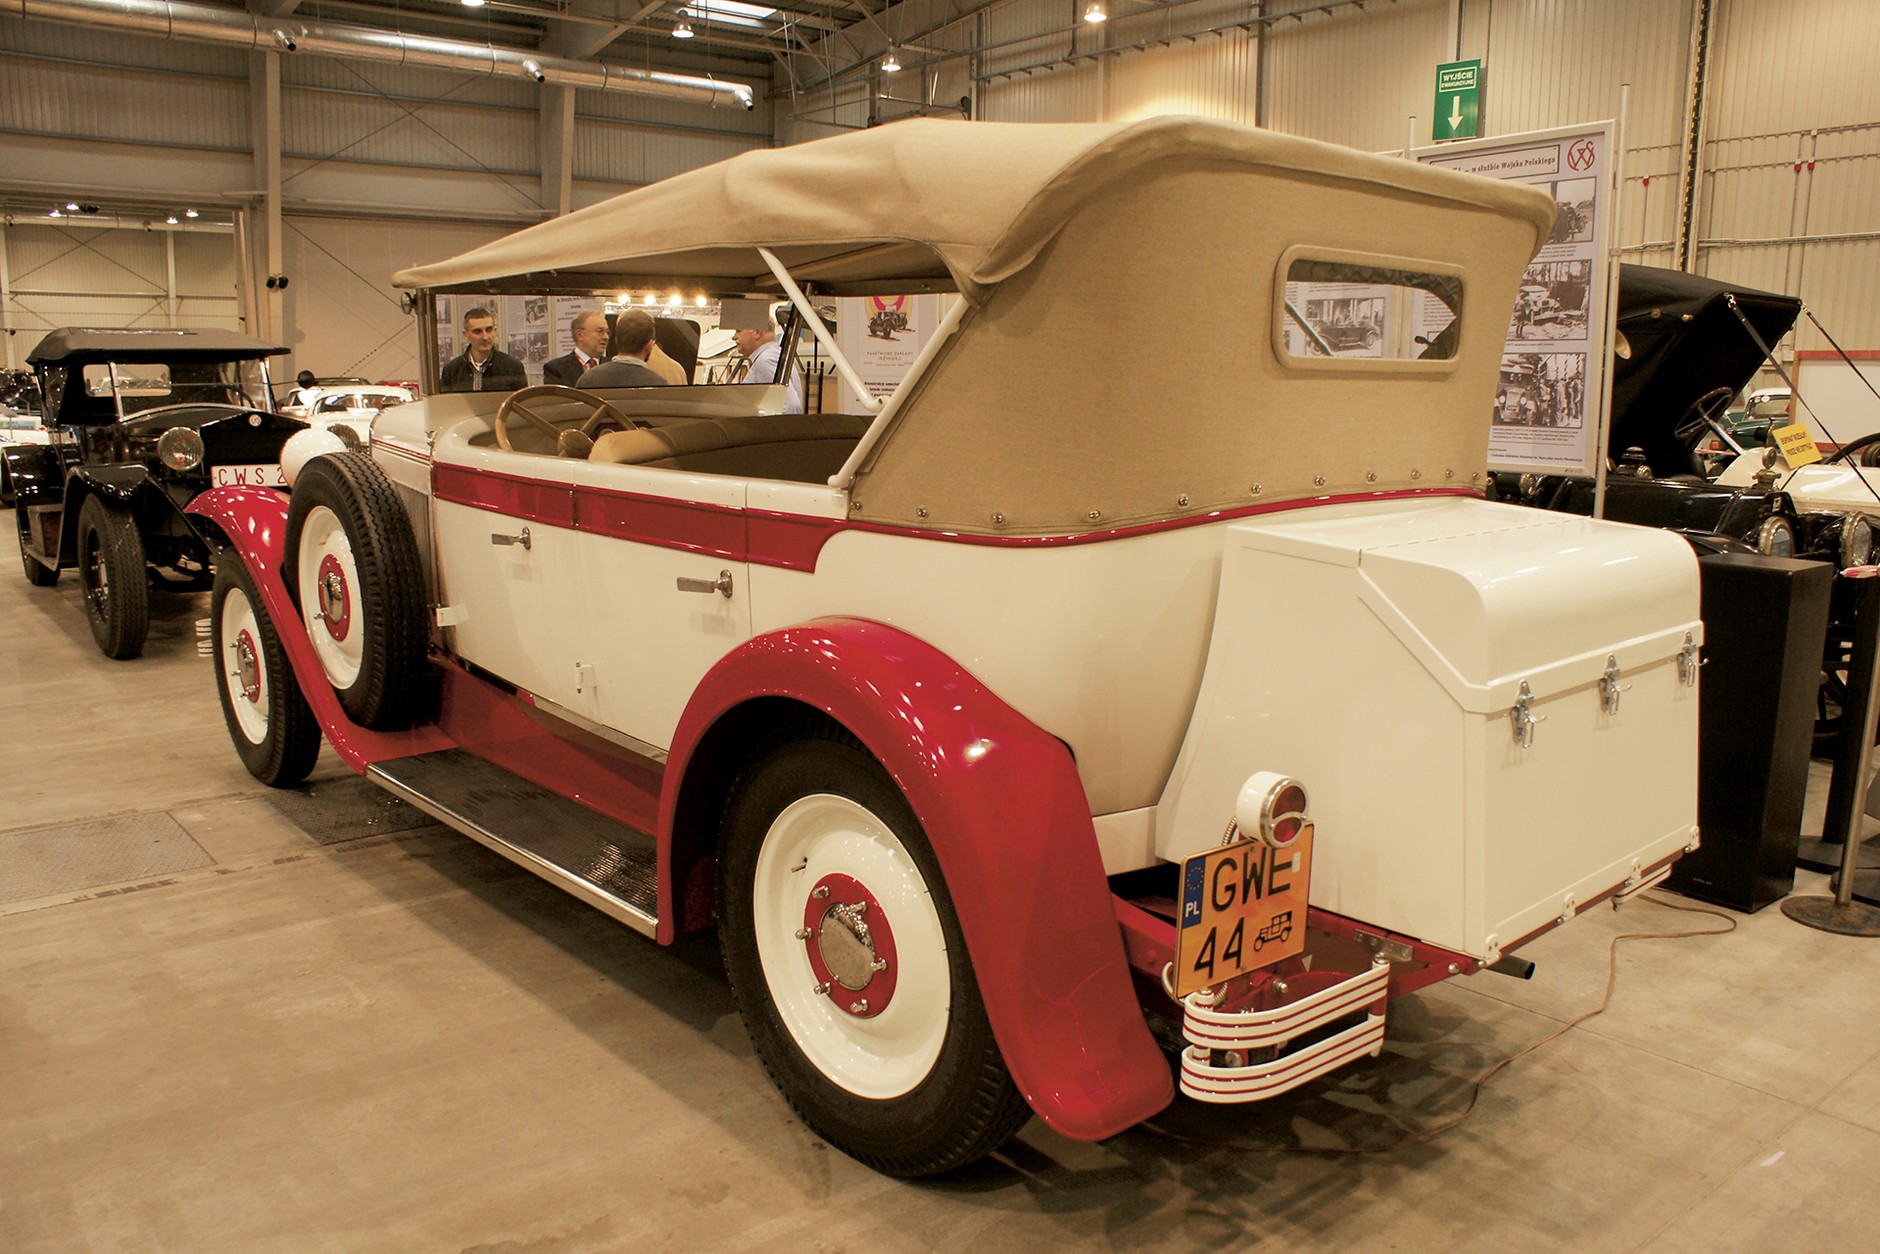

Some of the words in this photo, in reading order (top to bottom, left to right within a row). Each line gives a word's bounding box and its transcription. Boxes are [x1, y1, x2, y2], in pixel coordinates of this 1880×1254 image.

[1443, 71, 1473, 81] WYJŚCIE
[1501, 160, 1523, 170] Wojska
[1524, 157, 1556, 167] Polskiego
[1211, 846, 1293, 912] GWE
[1185, 900, 1200, 918] PL
[1194, 917, 1245, 980] 44
